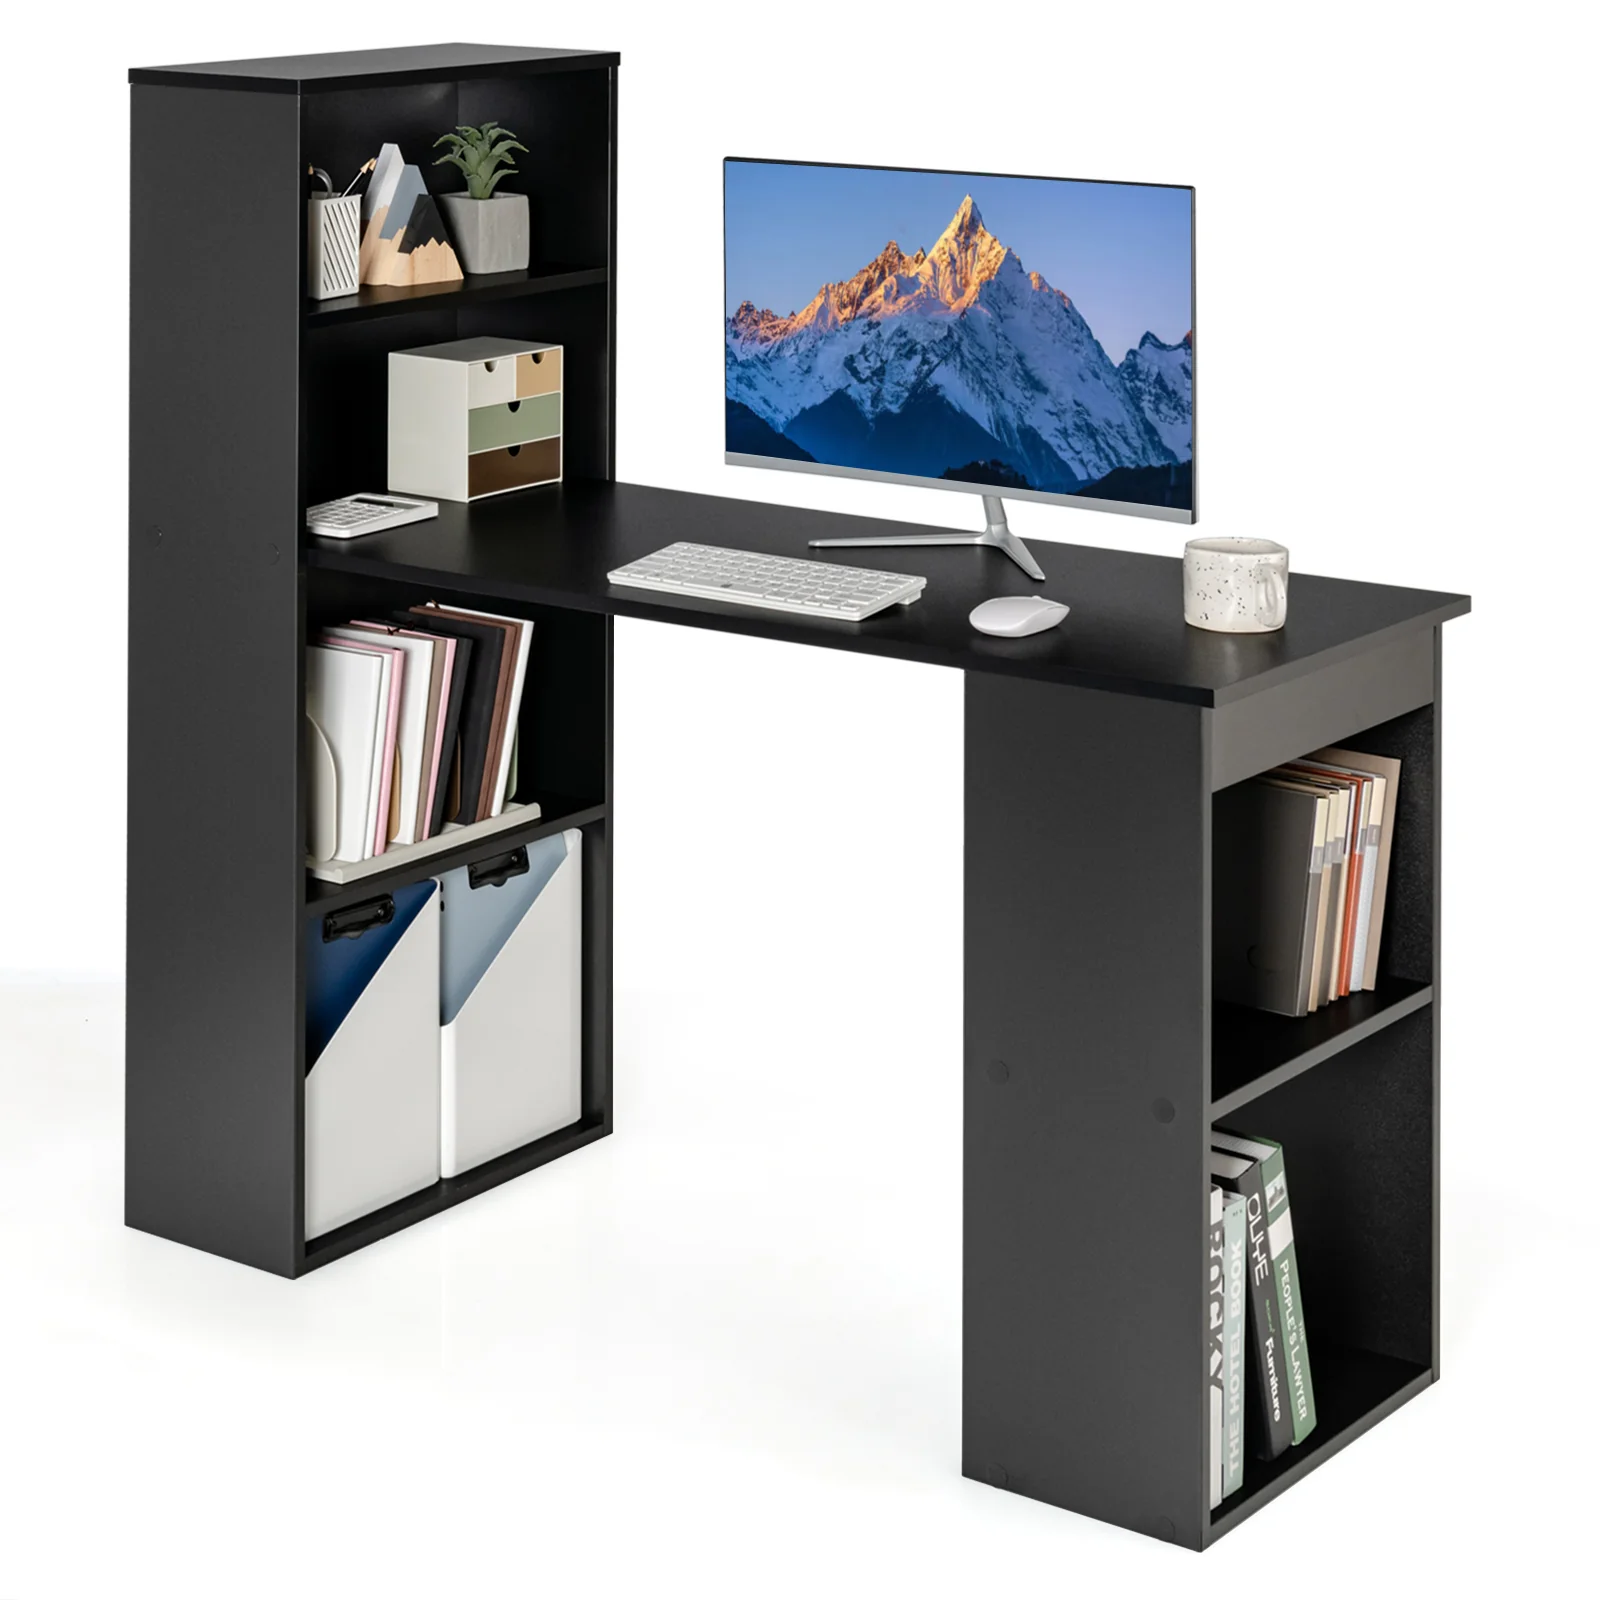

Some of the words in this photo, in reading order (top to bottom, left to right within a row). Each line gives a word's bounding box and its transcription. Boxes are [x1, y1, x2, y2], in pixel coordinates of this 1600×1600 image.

[1230, 1238, 1242, 1319] BOOK
[1229, 1322, 1241, 1416] HOTEL
[1265, 1336, 1281, 1422] Furniture
[1279, 1258, 1298, 1346] PEOPLE'S
[1291, 1345, 1308, 1421] LAWYER
[1229, 1418, 1240, 1478] THE
